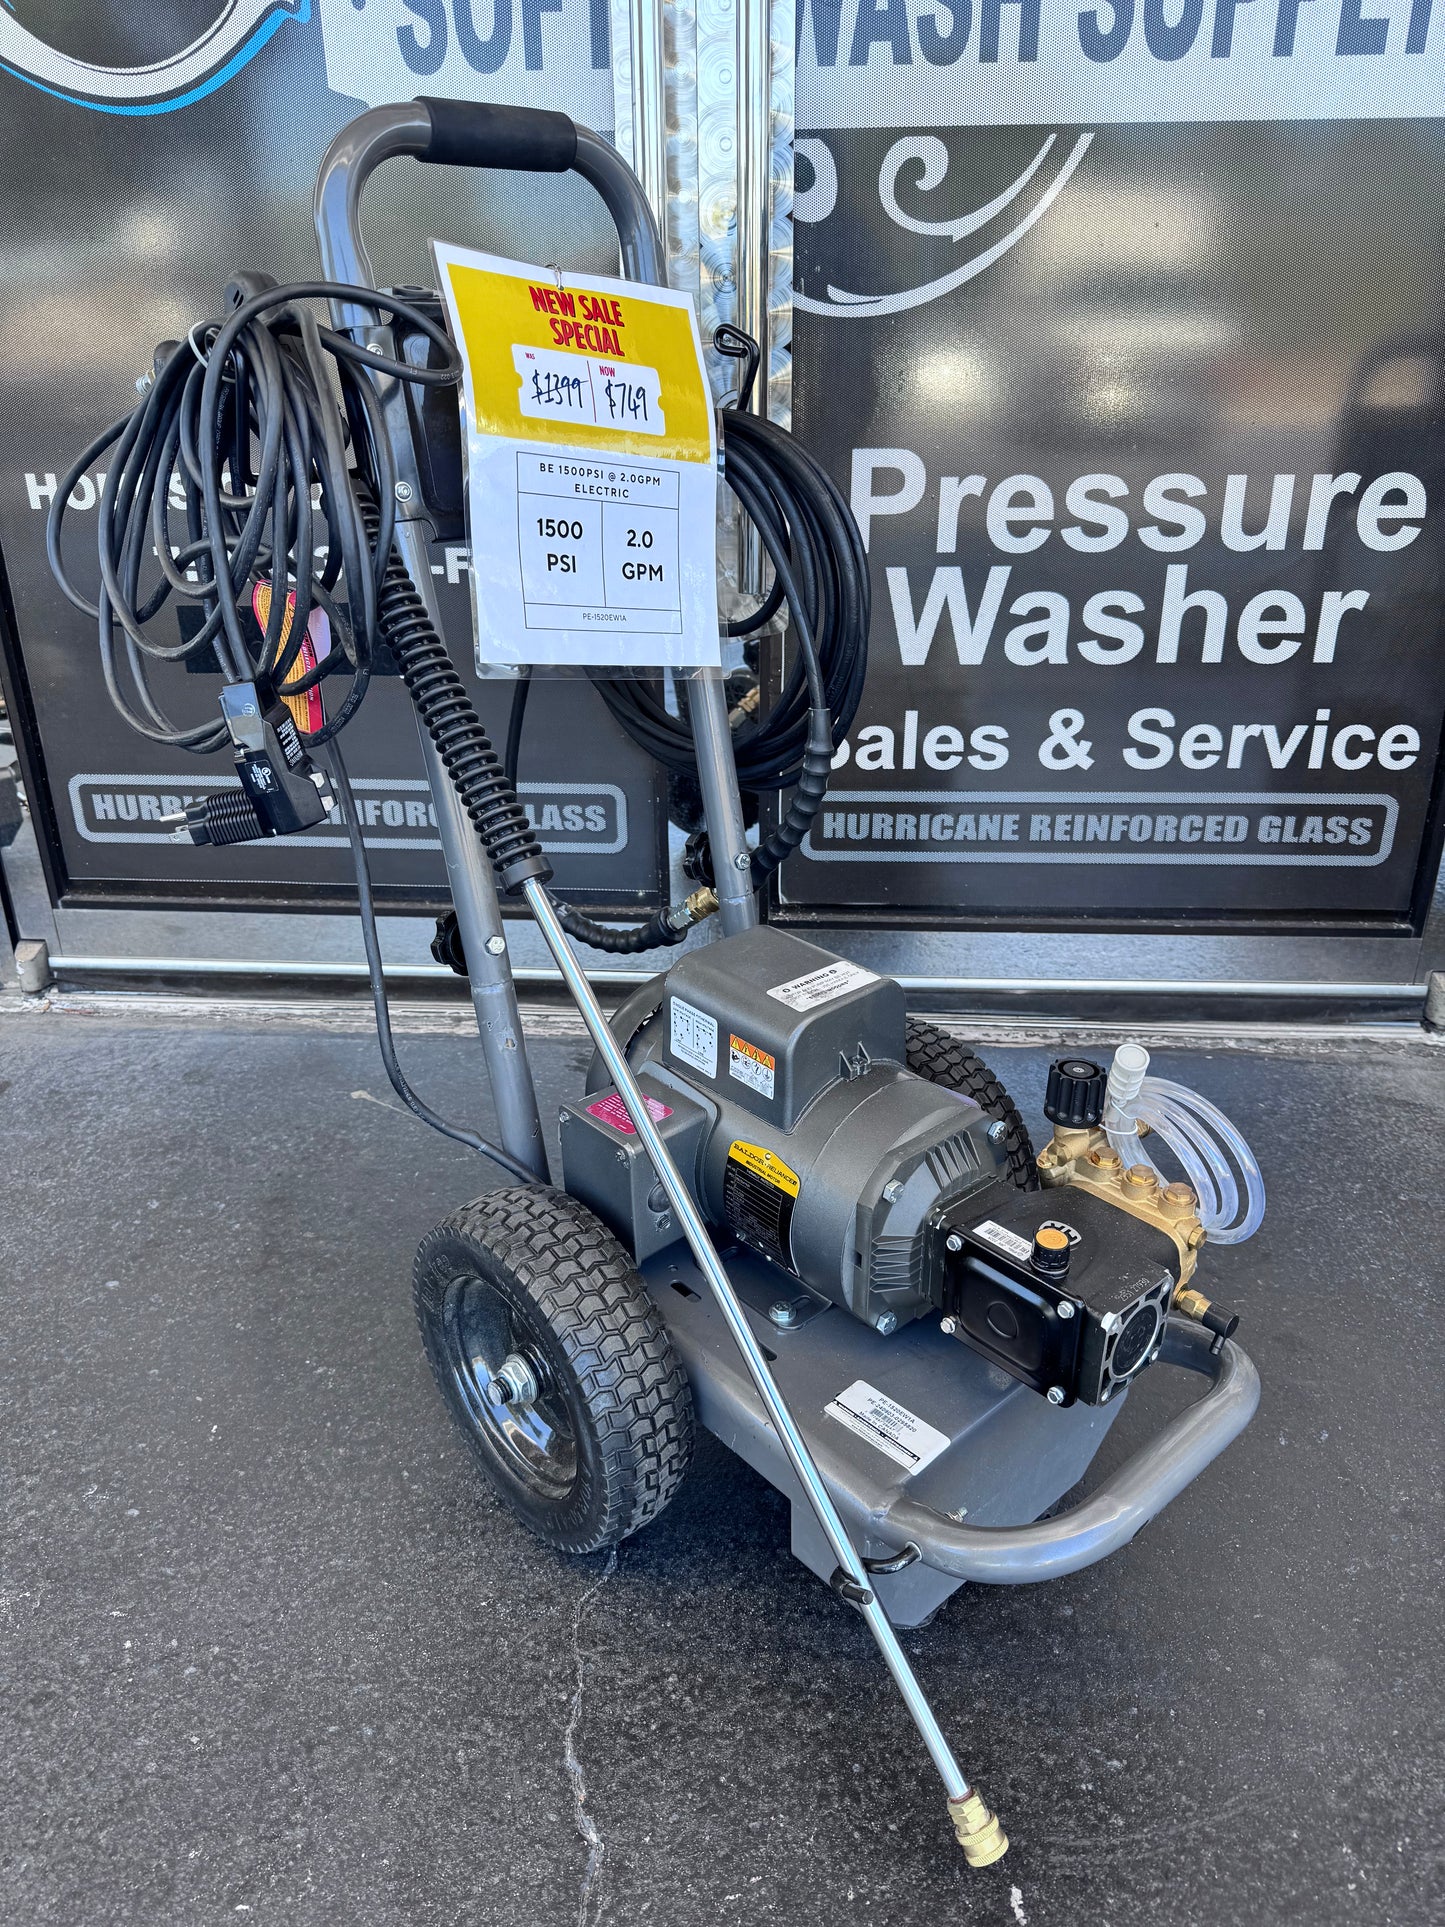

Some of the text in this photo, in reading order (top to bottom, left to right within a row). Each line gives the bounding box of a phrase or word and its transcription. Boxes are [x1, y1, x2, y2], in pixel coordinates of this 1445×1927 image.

[528, 286, 625, 327] NEW SALE
[549, 317, 625, 356] SPECIAL
[525, 352, 536, 360] WAS
[599, 365, 616, 377] NOW
[532, 369, 584, 408] $1399
[605, 379, 648, 421] $749
[539, 462, 661, 486] BE 1500PSI @ 2.0GPM
[575, 483, 629, 498] ELECTRIC
[851, 448, 1427, 553] Pressure
[537, 518, 583, 539] 1500
[626, 529, 653, 548] 2.0
[547, 553, 576, 573] PSI
[622, 562, 663, 582] GPM
[886, 564, 1371, 667] Washer
[1038, 708, 1095, 771] &
[1122, 707, 1420, 771] Service
[523, 804, 607, 831] LASS
[823, 812, 1373, 846] HURRICANE REINFORCED GLASS
[791, 972, 830, 990] WARNING
